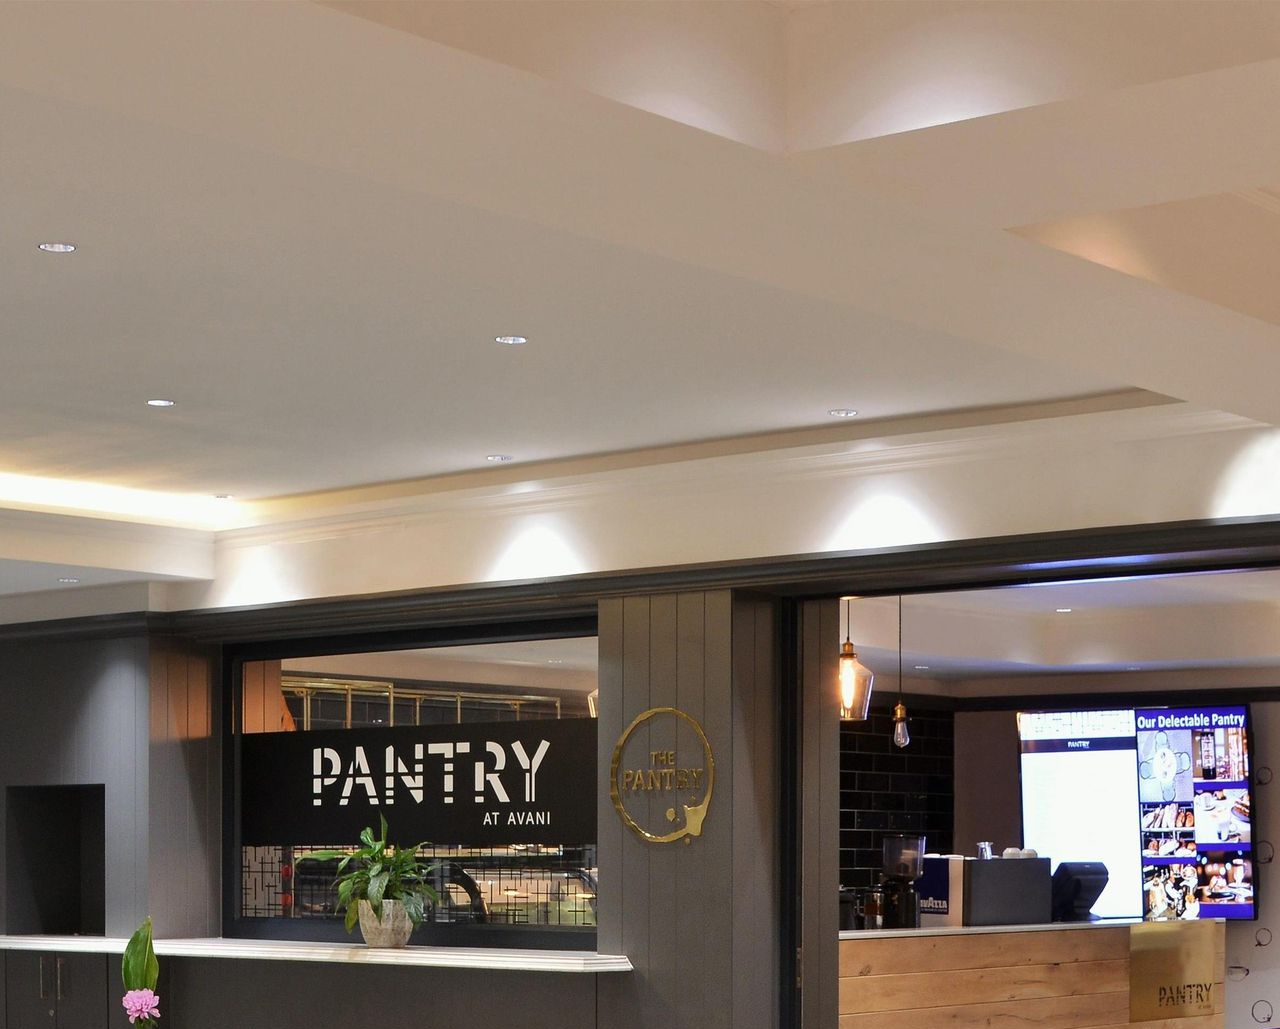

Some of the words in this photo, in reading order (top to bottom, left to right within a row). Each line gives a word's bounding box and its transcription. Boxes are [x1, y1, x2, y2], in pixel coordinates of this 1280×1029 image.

[1137, 716, 1156, 729] Our
[1158, 713, 1210, 728] Delectable
[1211, 713, 1245, 727] Pantry
[650, 751, 676, 765] THE
[313, 739, 550, 806] PANTRY
[622, 768, 703, 791] PANTRY
[483, 812, 500, 826] AT
[507, 811, 551, 825] AVANI
[1158, 983, 1212, 1007] PANTRY
